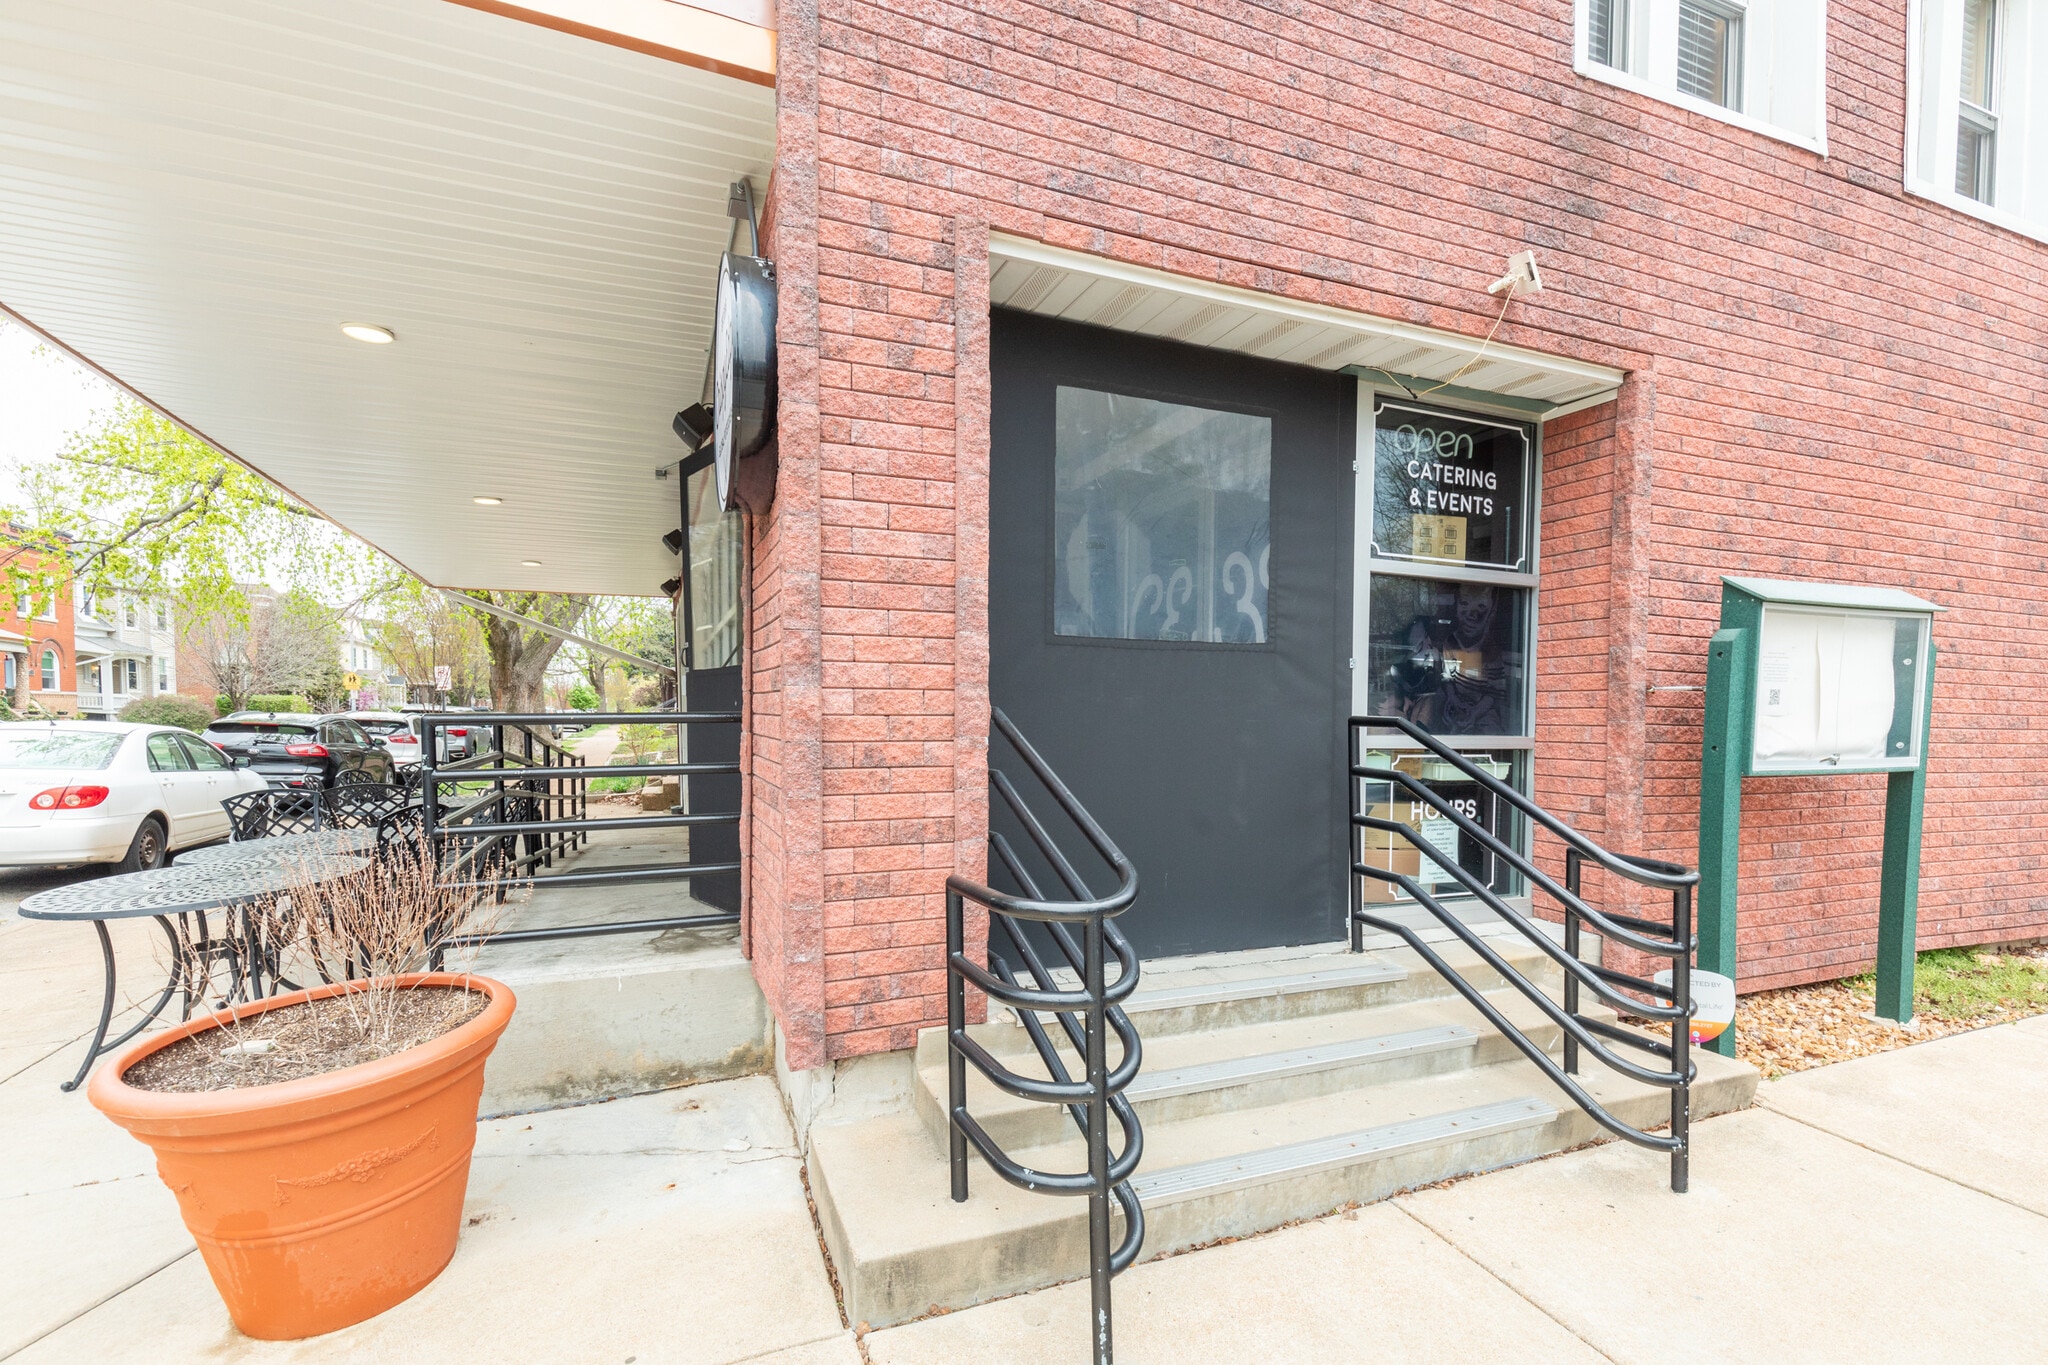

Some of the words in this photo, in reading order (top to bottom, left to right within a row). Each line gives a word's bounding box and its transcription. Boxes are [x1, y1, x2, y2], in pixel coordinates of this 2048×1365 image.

[1394, 424, 1473, 459] open
[1407, 460, 1497, 490] CATERING
[1409, 488, 1421, 507] &
[1427, 490, 1493, 516] EVENTS
